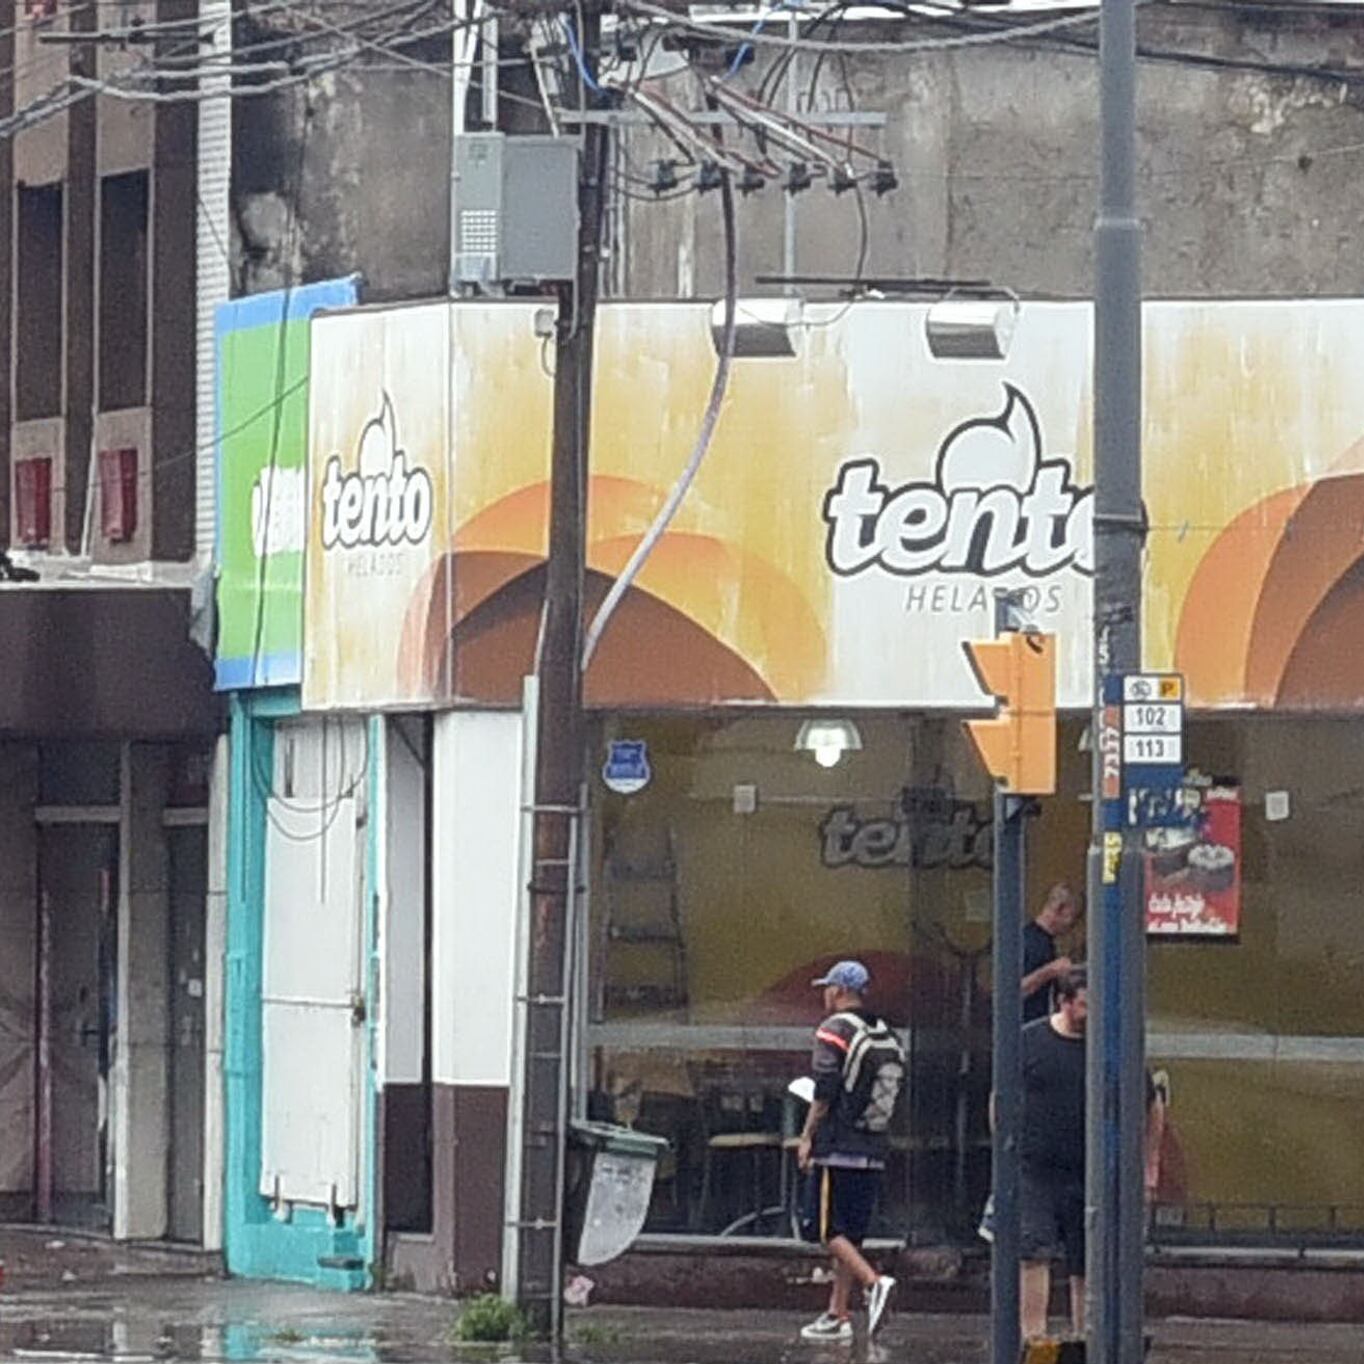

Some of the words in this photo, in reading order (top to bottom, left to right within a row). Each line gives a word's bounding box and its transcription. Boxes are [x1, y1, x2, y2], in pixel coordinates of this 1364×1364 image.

[321, 452, 434, 550] tento
[822, 457, 1095, 578] tent
[906, 585, 1064, 613] HELAOS
[1136, 706, 1166, 726] 102
[1136, 738, 1165, 758] 113
